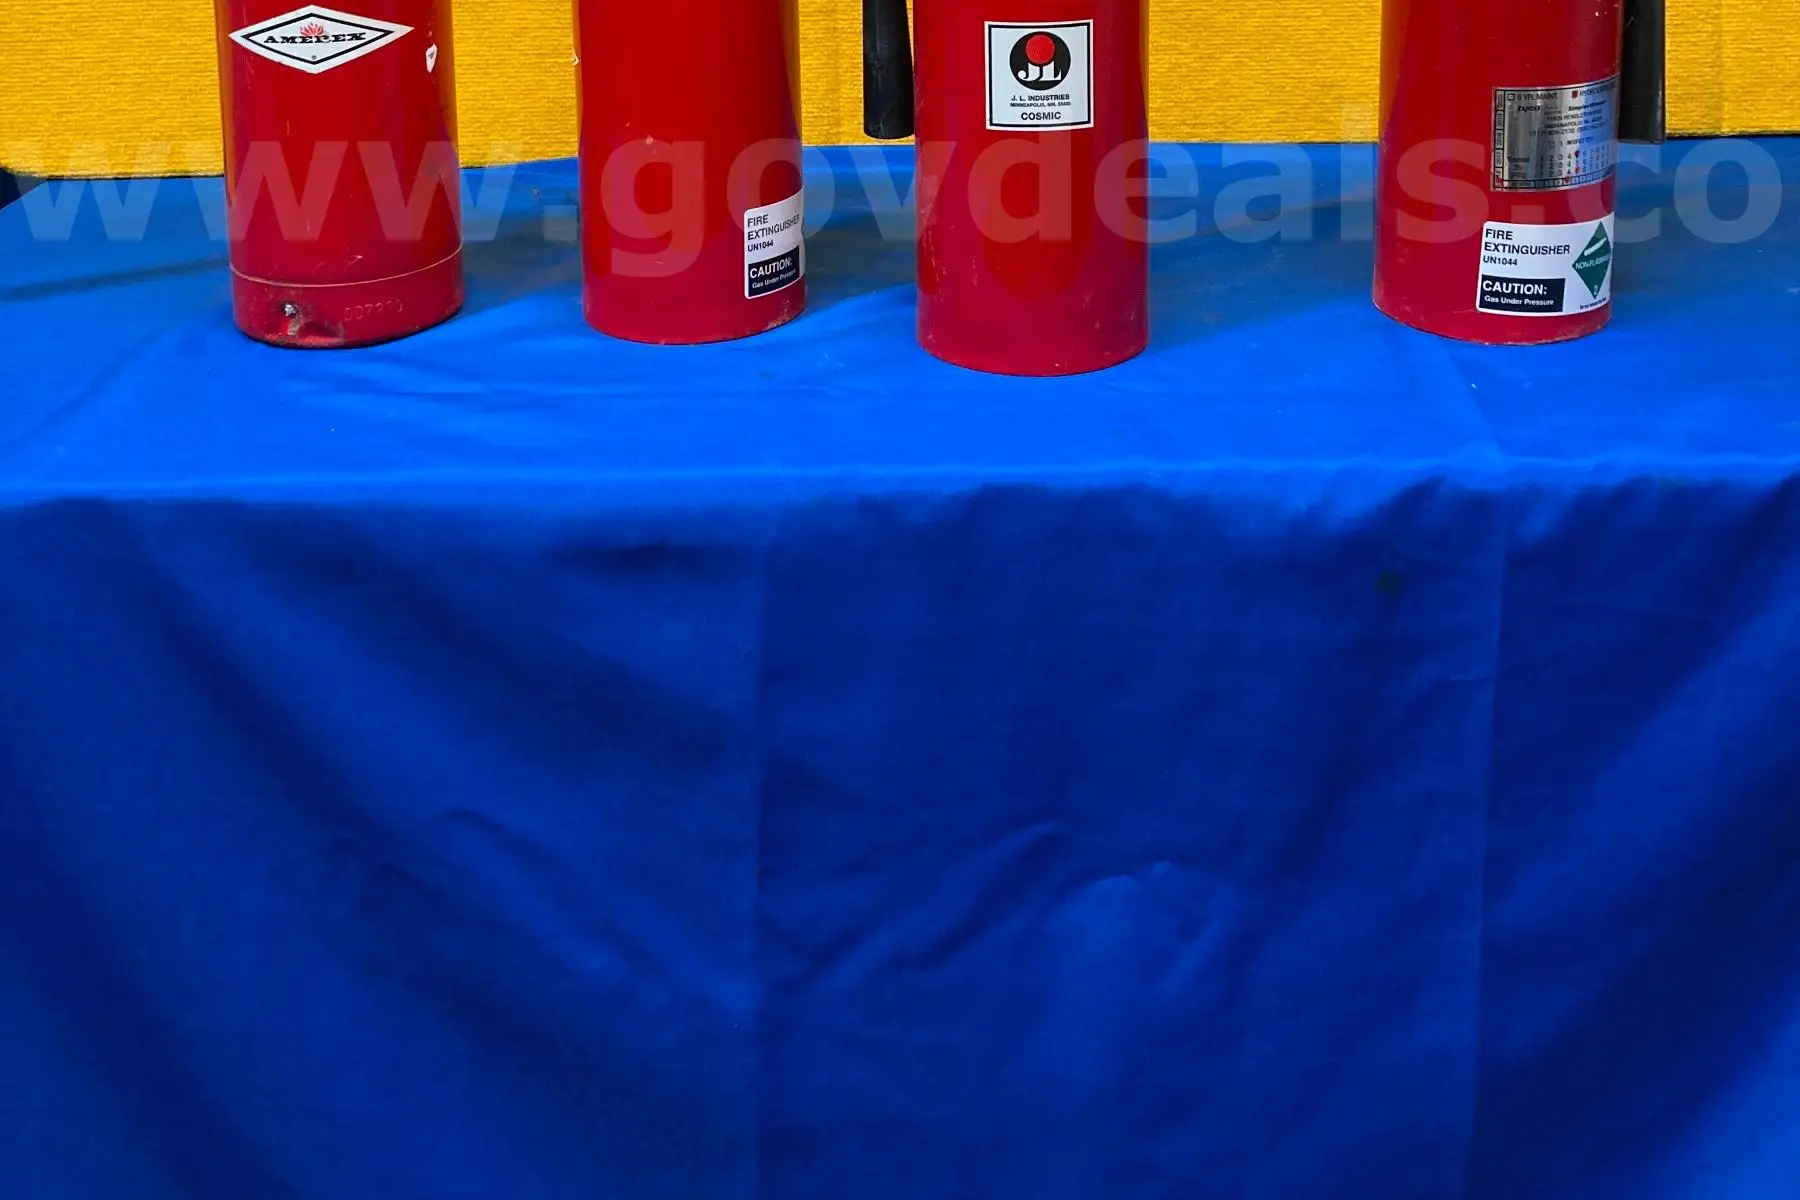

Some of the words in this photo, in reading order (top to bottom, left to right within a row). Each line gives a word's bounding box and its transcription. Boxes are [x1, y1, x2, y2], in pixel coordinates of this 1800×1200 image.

[263, 31, 367, 44] AMEREX
[1028, 93, 1070, 101] INDUSTRIES
[1020, 111, 1062, 121] COSMIC
[747, 213, 769, 228] FIRE
[747, 213, 800, 241] EXTINGUISHER
[1485, 228, 1513, 241] FIRE
[747, 239, 774, 252] UN1044
[1484, 241, 1570, 255] EXTINGUISHER
[1482, 255, 1518, 266] UN1044
[749, 256, 793, 279] CAUTION:
[752, 279, 764, 289] Gas
[764, 275, 779, 286] Under
[1482, 280, 1548, 295] CAUTION:
[1484, 295, 1500, 303] Gas
[1500, 296, 1522, 305] Under
[1524, 298, 1554, 306] Pressure
